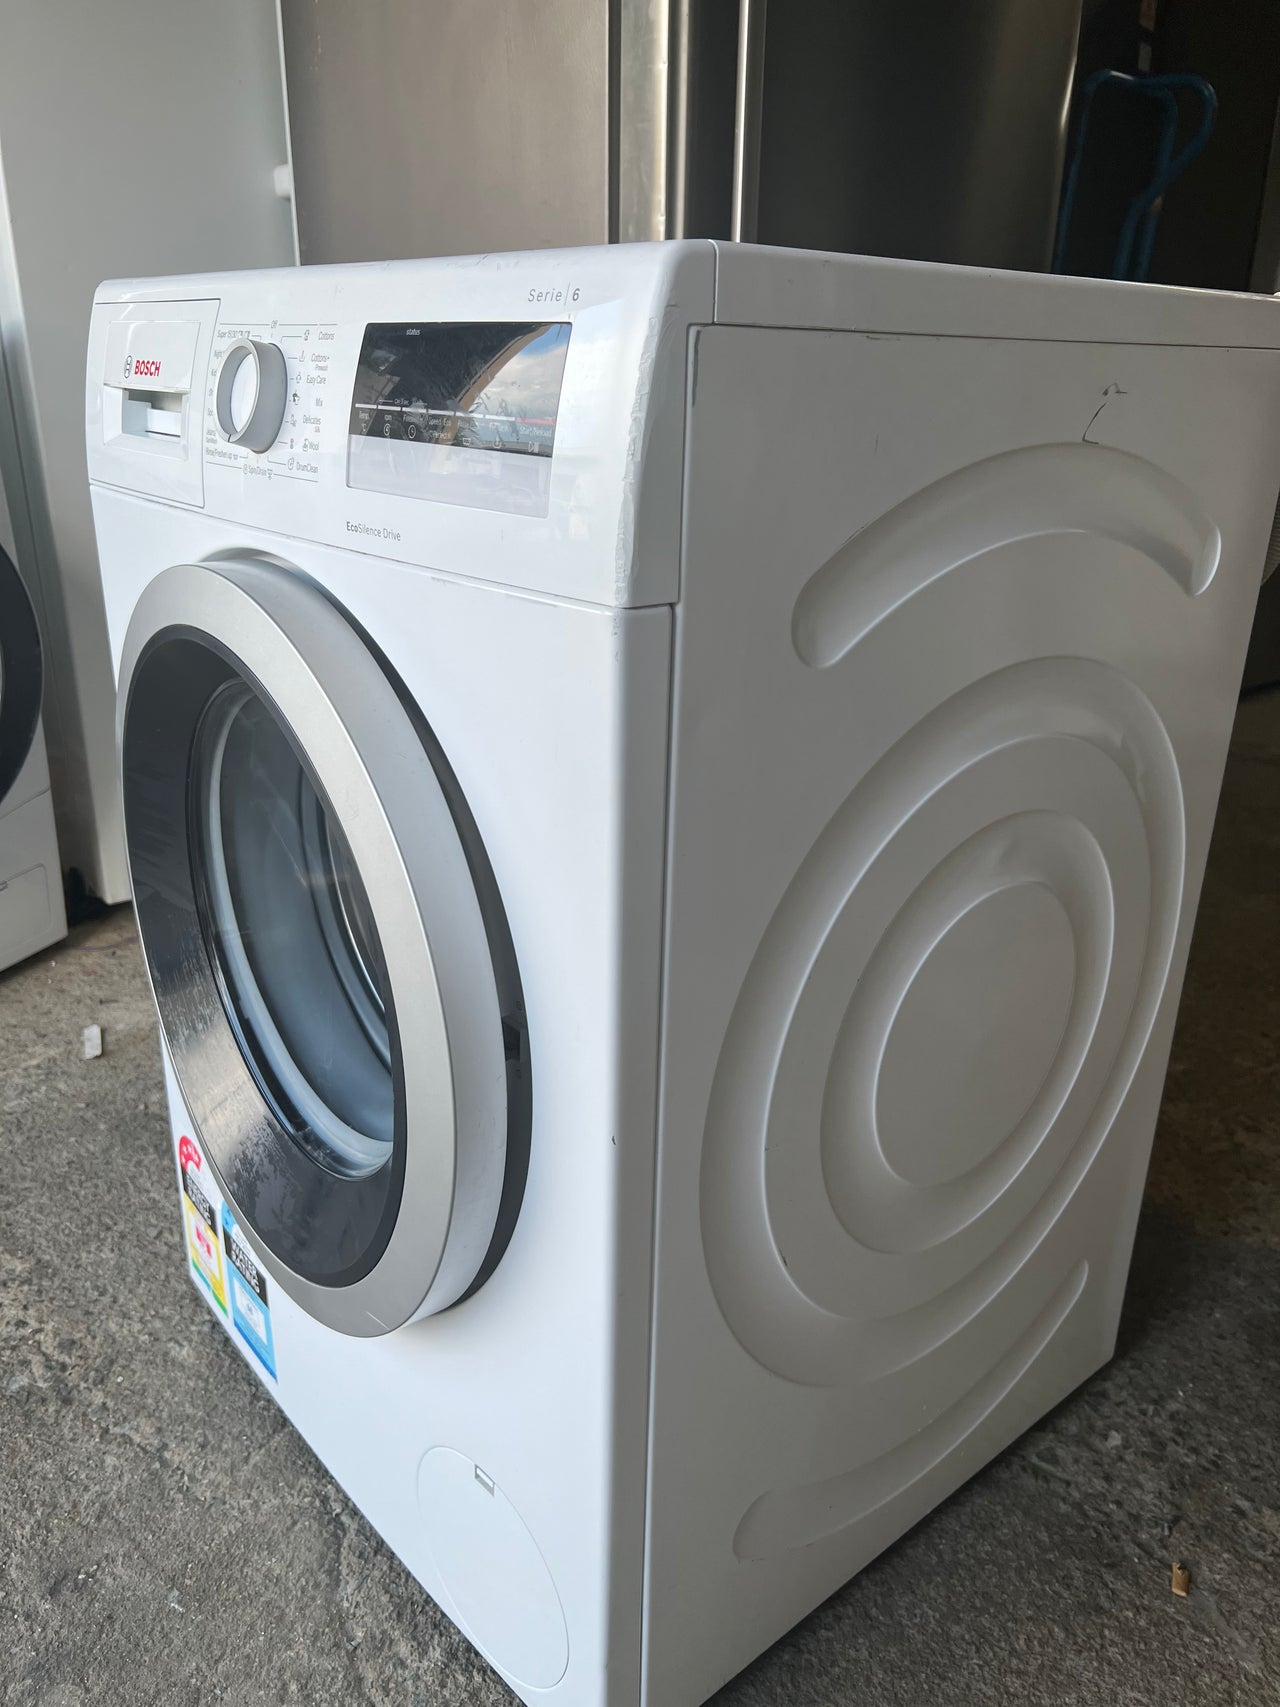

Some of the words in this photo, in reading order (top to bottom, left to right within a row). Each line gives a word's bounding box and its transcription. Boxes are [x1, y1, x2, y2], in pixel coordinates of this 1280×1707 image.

[527, 287, 562, 302] Serie
[572, 287, 581, 302] 6
[318, 331, 336, 341] Cottons
[406, 328, 421, 336] status
[134, 359, 162, 377] BOSCH
[306, 374, 316, 386] Easy
[316, 375, 328, 385] Care
[346, 520, 382, 538] EcoSilence
[382, 528, 401, 542] Drive
[230, 1237, 258, 1280] WATER
[230, 1251, 260, 1294] RATING
